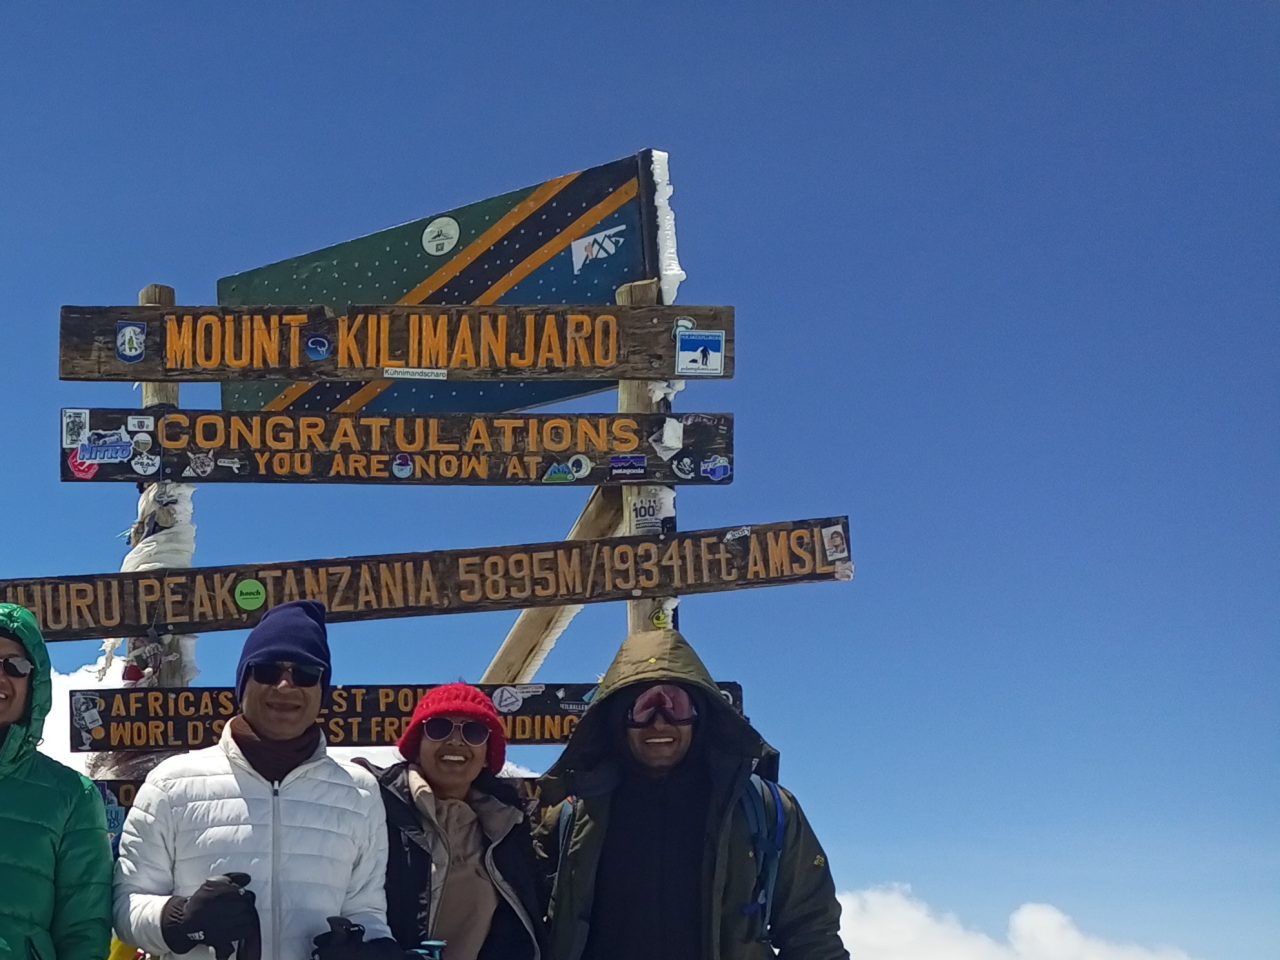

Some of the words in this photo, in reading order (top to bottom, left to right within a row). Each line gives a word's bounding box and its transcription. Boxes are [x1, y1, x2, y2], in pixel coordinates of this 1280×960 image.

[166, 313, 309, 369] MOUNT
[337, 313, 618, 369] KILIMANJARO
[157, 413, 640, 452] CONGRATULATIONS
[254, 452, 312, 476] YOU
[329, 453, 390, 477] ARE
[414, 454, 489, 479] NOW
[506, 455, 543, 482] AT
[632, 505, 656, 519] 100
[746, 527, 836, 580] AMSL
